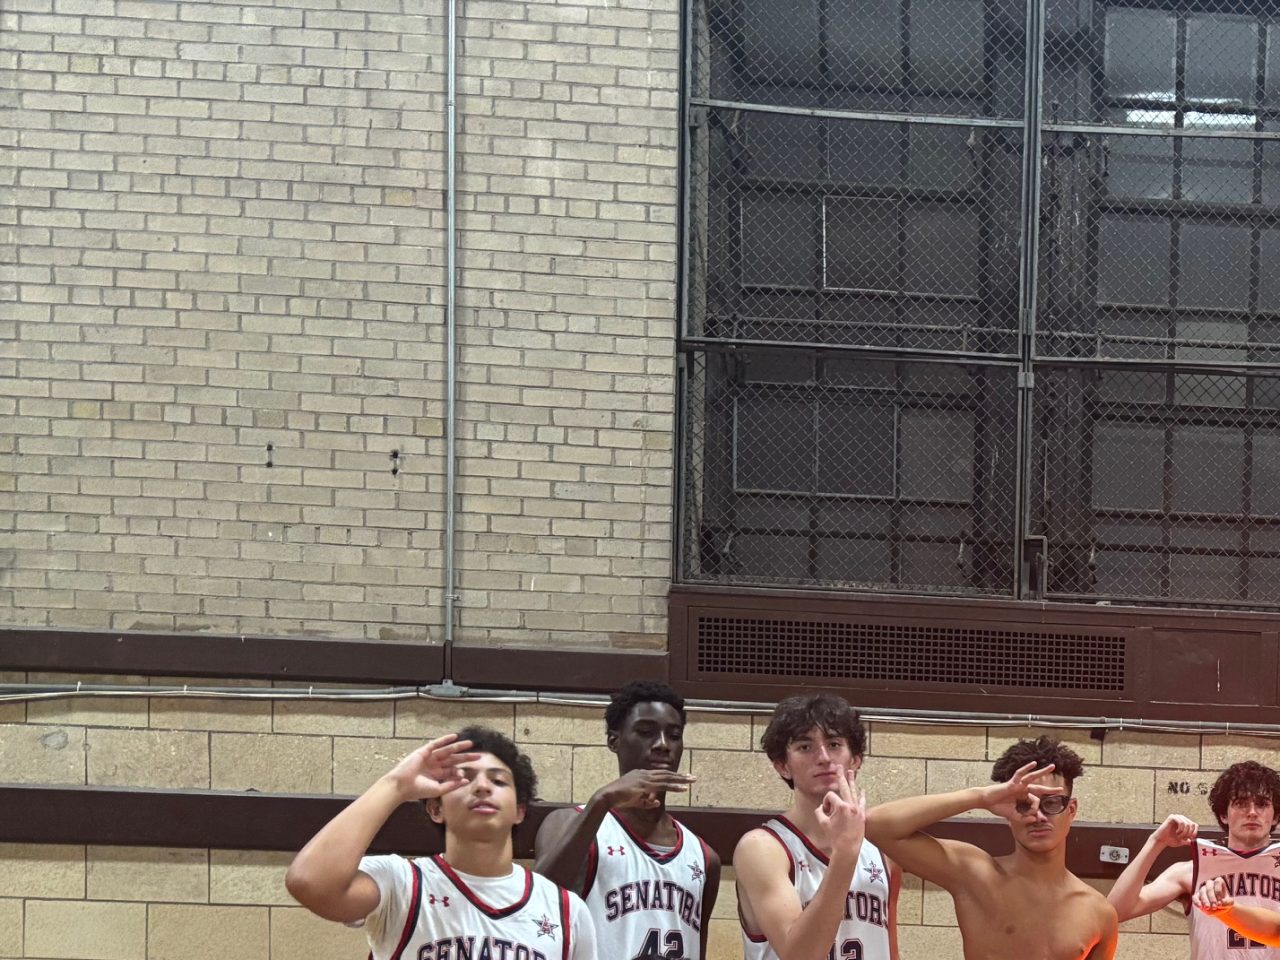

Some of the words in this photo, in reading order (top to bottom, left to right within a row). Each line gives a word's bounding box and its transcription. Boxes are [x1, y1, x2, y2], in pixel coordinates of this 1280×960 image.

[1168, 781, 1190, 794] NO
[604, 880, 700, 933] SENATORS
[638, 928, 684, 960] 42
